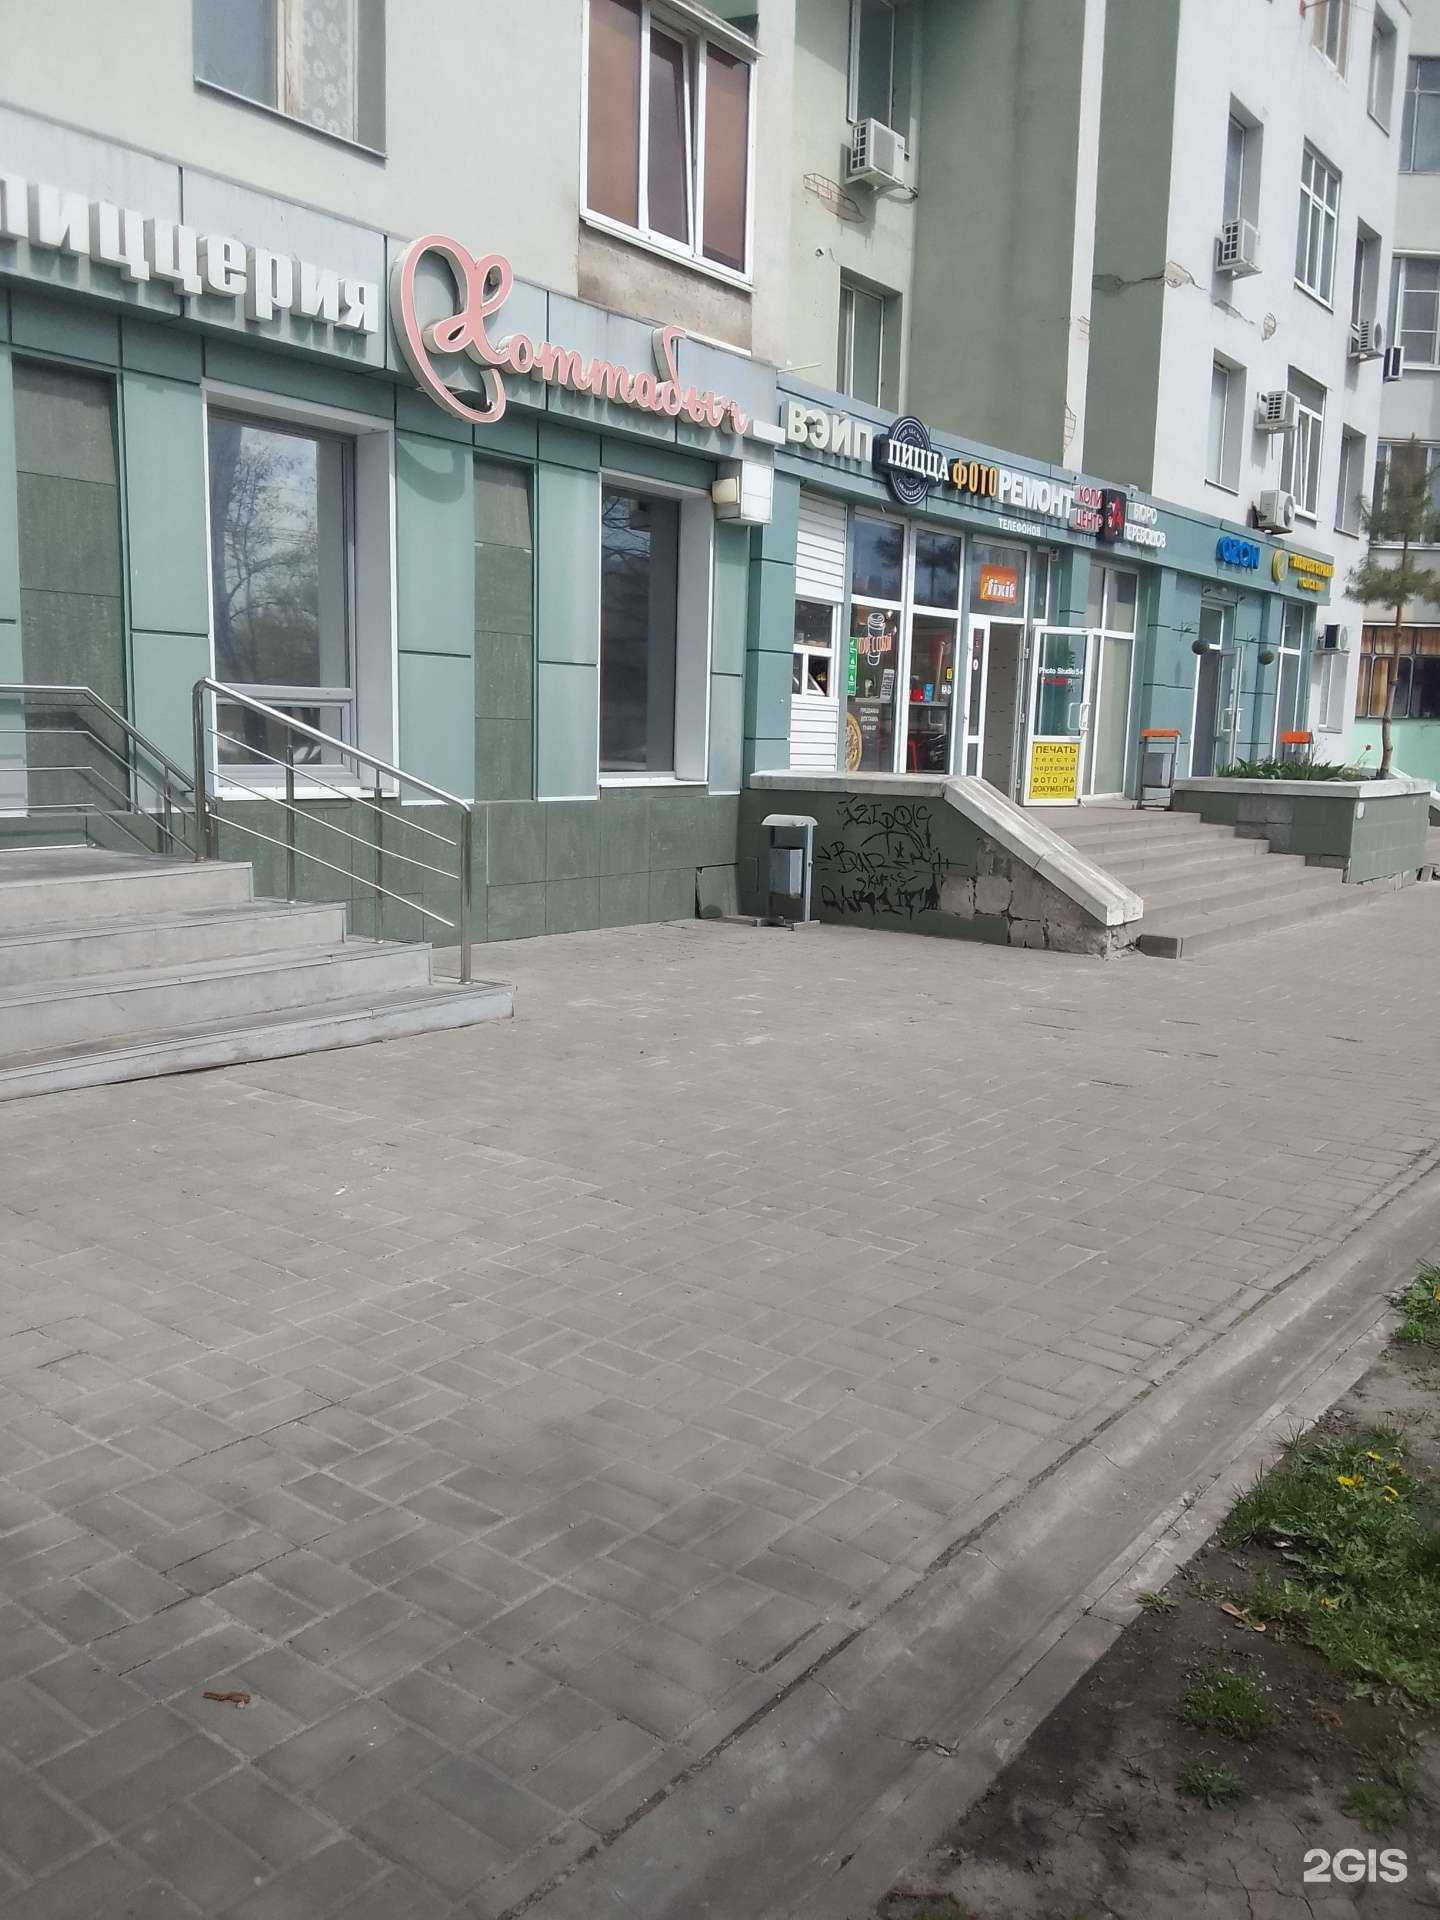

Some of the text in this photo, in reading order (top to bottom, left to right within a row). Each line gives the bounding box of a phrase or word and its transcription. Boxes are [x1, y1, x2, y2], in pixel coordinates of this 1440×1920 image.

[786, 400, 873, 462] ВЭЙП
[888, 438, 949, 481] ПИЦЦА
[952, 457, 998, 497] ФОТО
[998, 468, 1073, 519] РЕМОНТ
[1035, 745, 1077, 754] ПЕЧАТЬ
[1032, 785, 1075, 793] ДОКУМЕНТЫ
[1033, 776, 1075, 784] ФОТО НА
